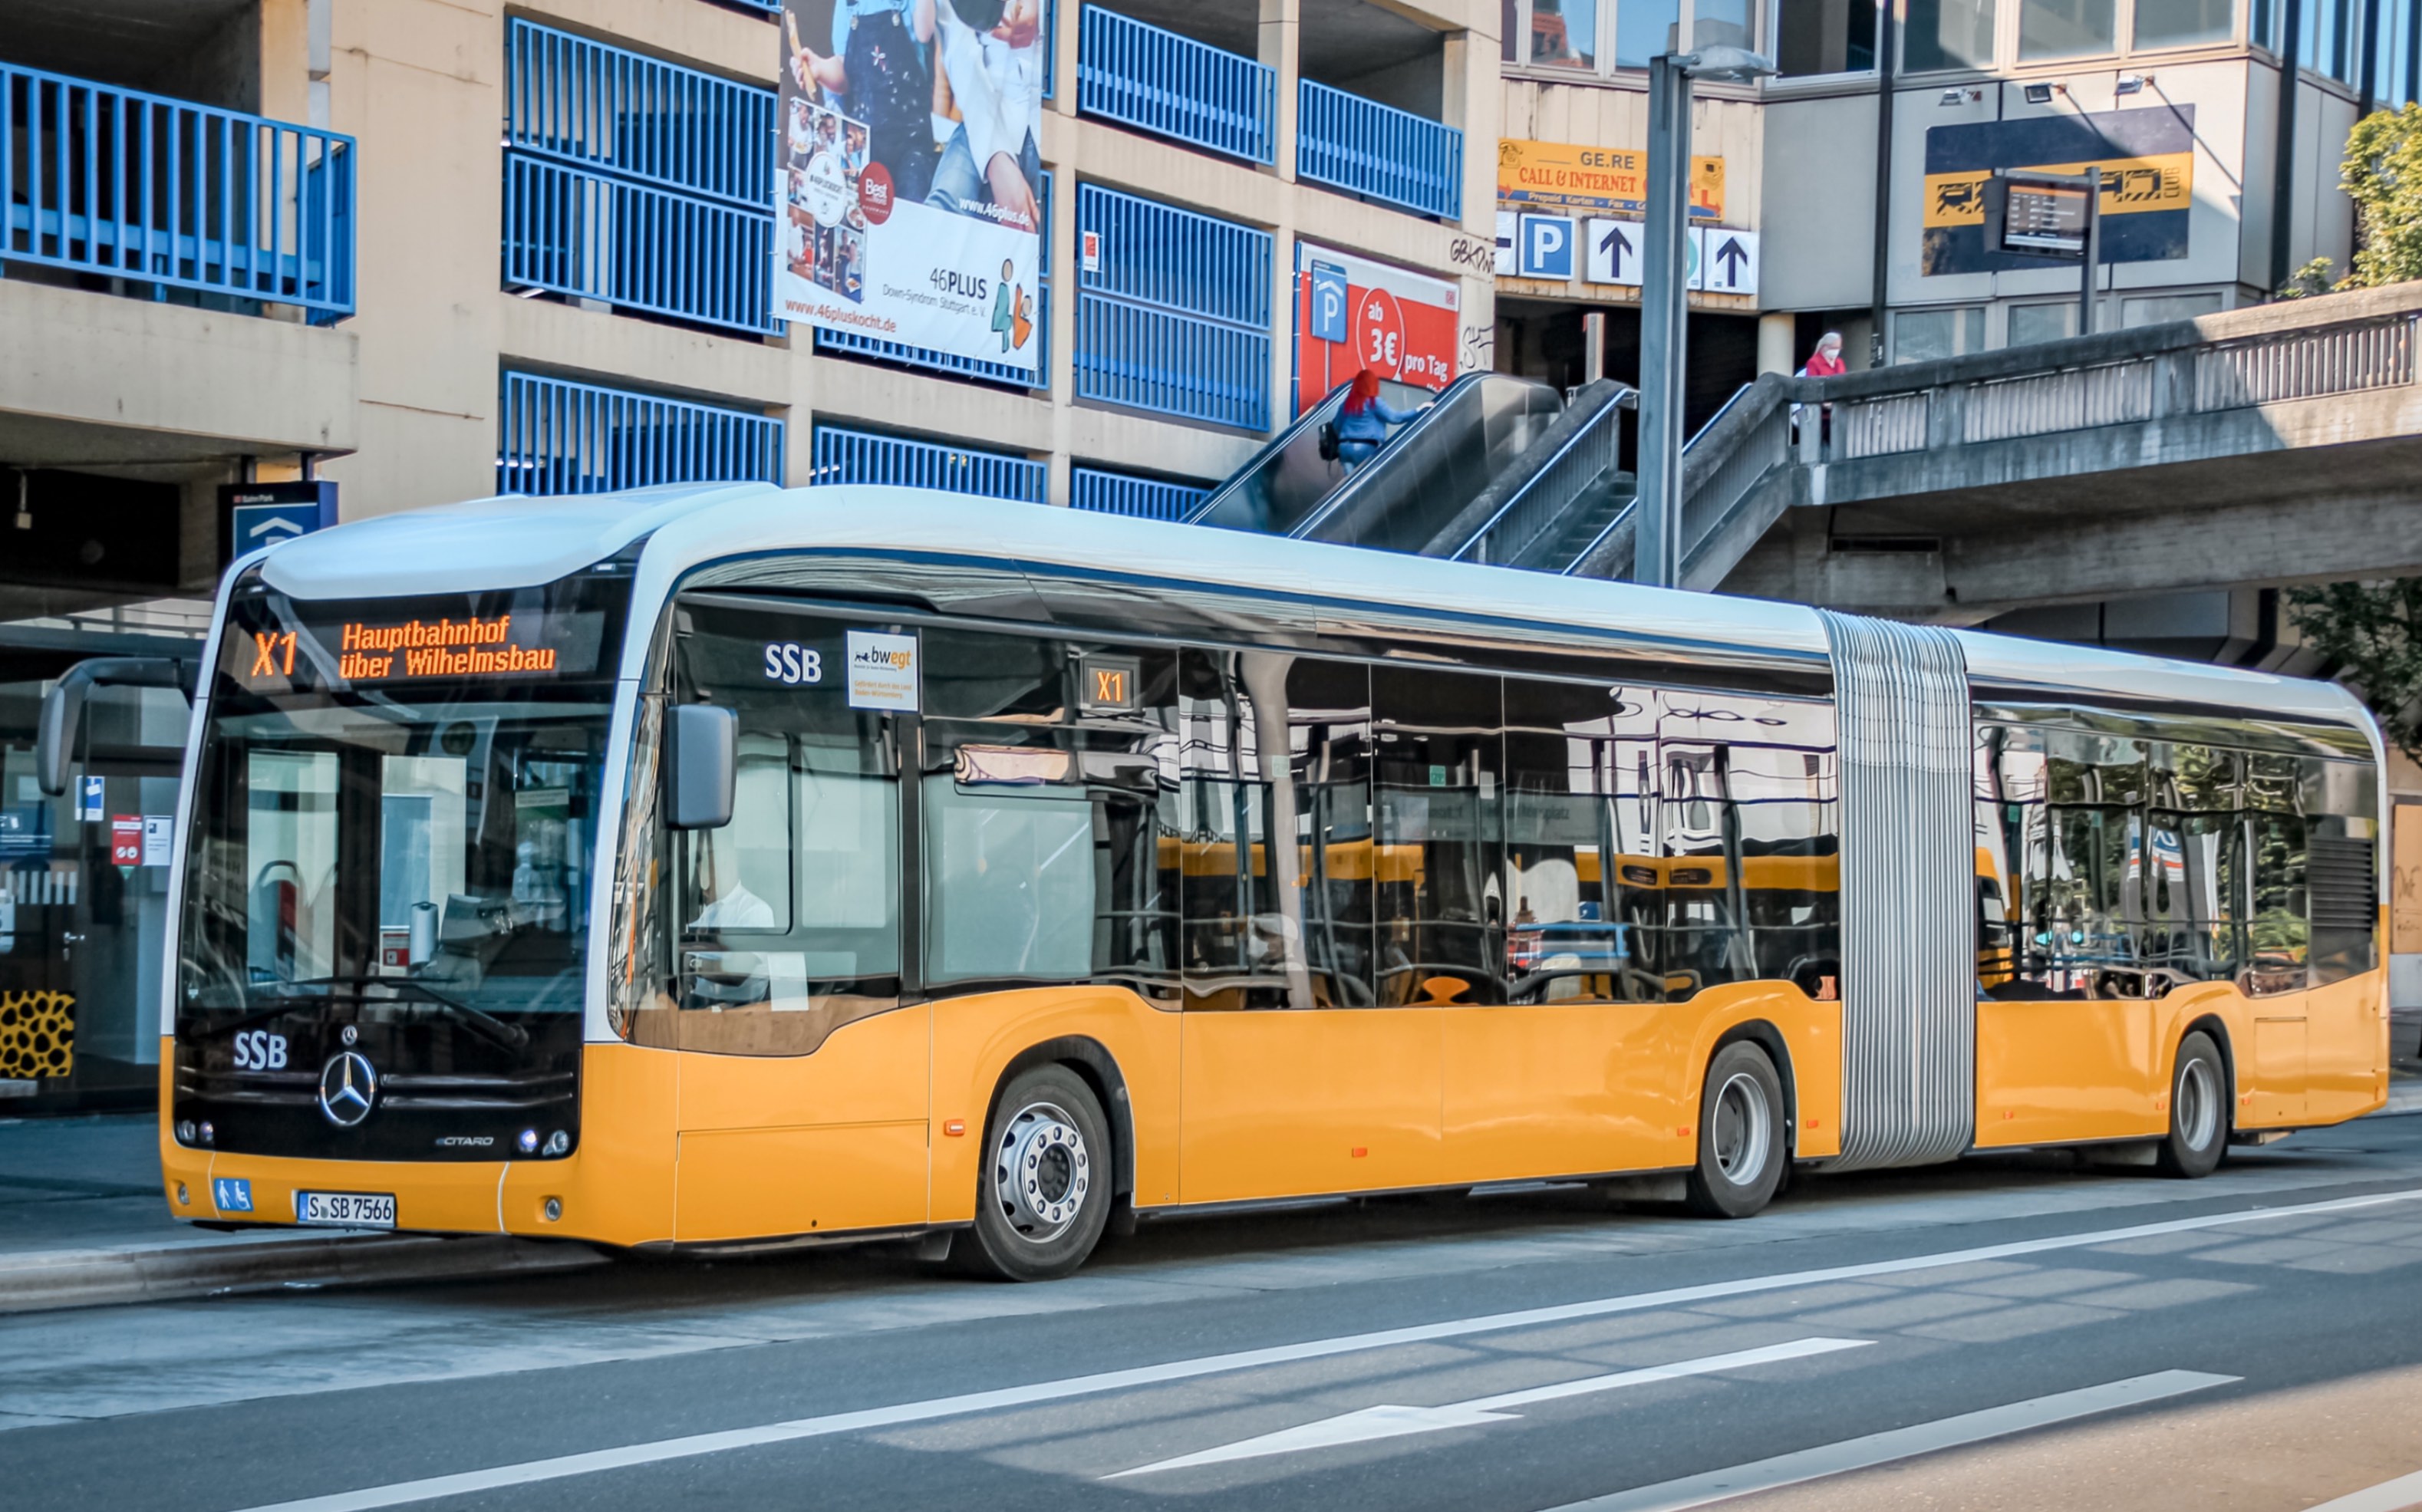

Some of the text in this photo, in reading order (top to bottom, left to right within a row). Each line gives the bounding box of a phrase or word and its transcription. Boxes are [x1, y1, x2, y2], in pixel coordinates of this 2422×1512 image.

[1580, 152, 1635, 170] GE.RE
[865, 178, 888, 199] Best
[1519, 166, 1553, 186] CALL
[1556, 170, 1566, 187] &
[1570, 171, 1636, 193] INTERNET
[2163, 167, 2180, 199] CLUB
[958, 198, 1030, 226] www.46plus.de
[1528, 192, 1562, 203] Prepaid
[1565, 195, 1595, 206] Karten
[1607, 199, 1624, 209] Fax
[1534, 223, 1564, 268] P
[930, 267, 987, 300] 46PLUS
[883, 284, 938, 307] Down-Syndrom
[940, 296, 970, 315] Stuttgart
[1324, 293, 1338, 331] P
[1368, 301, 1383, 321] ab
[786, 299, 897, 333] www.46pluskocht.de
[1369, 328, 1398, 366] 3€
[1405, 354, 1448, 381] pro Tag
[341, 615, 511, 652] Hauptbahnhof
[251, 630, 298, 677] X1
[338, 644, 555, 679] über Wilhelmsbau
[766, 643, 822, 684] SSB
[872, 645, 911, 670] bwegt
[1096, 671, 1124, 702] X1
[234, 1030, 288, 1070] SSB
[309, 1196, 392, 1220] S SB 7566
